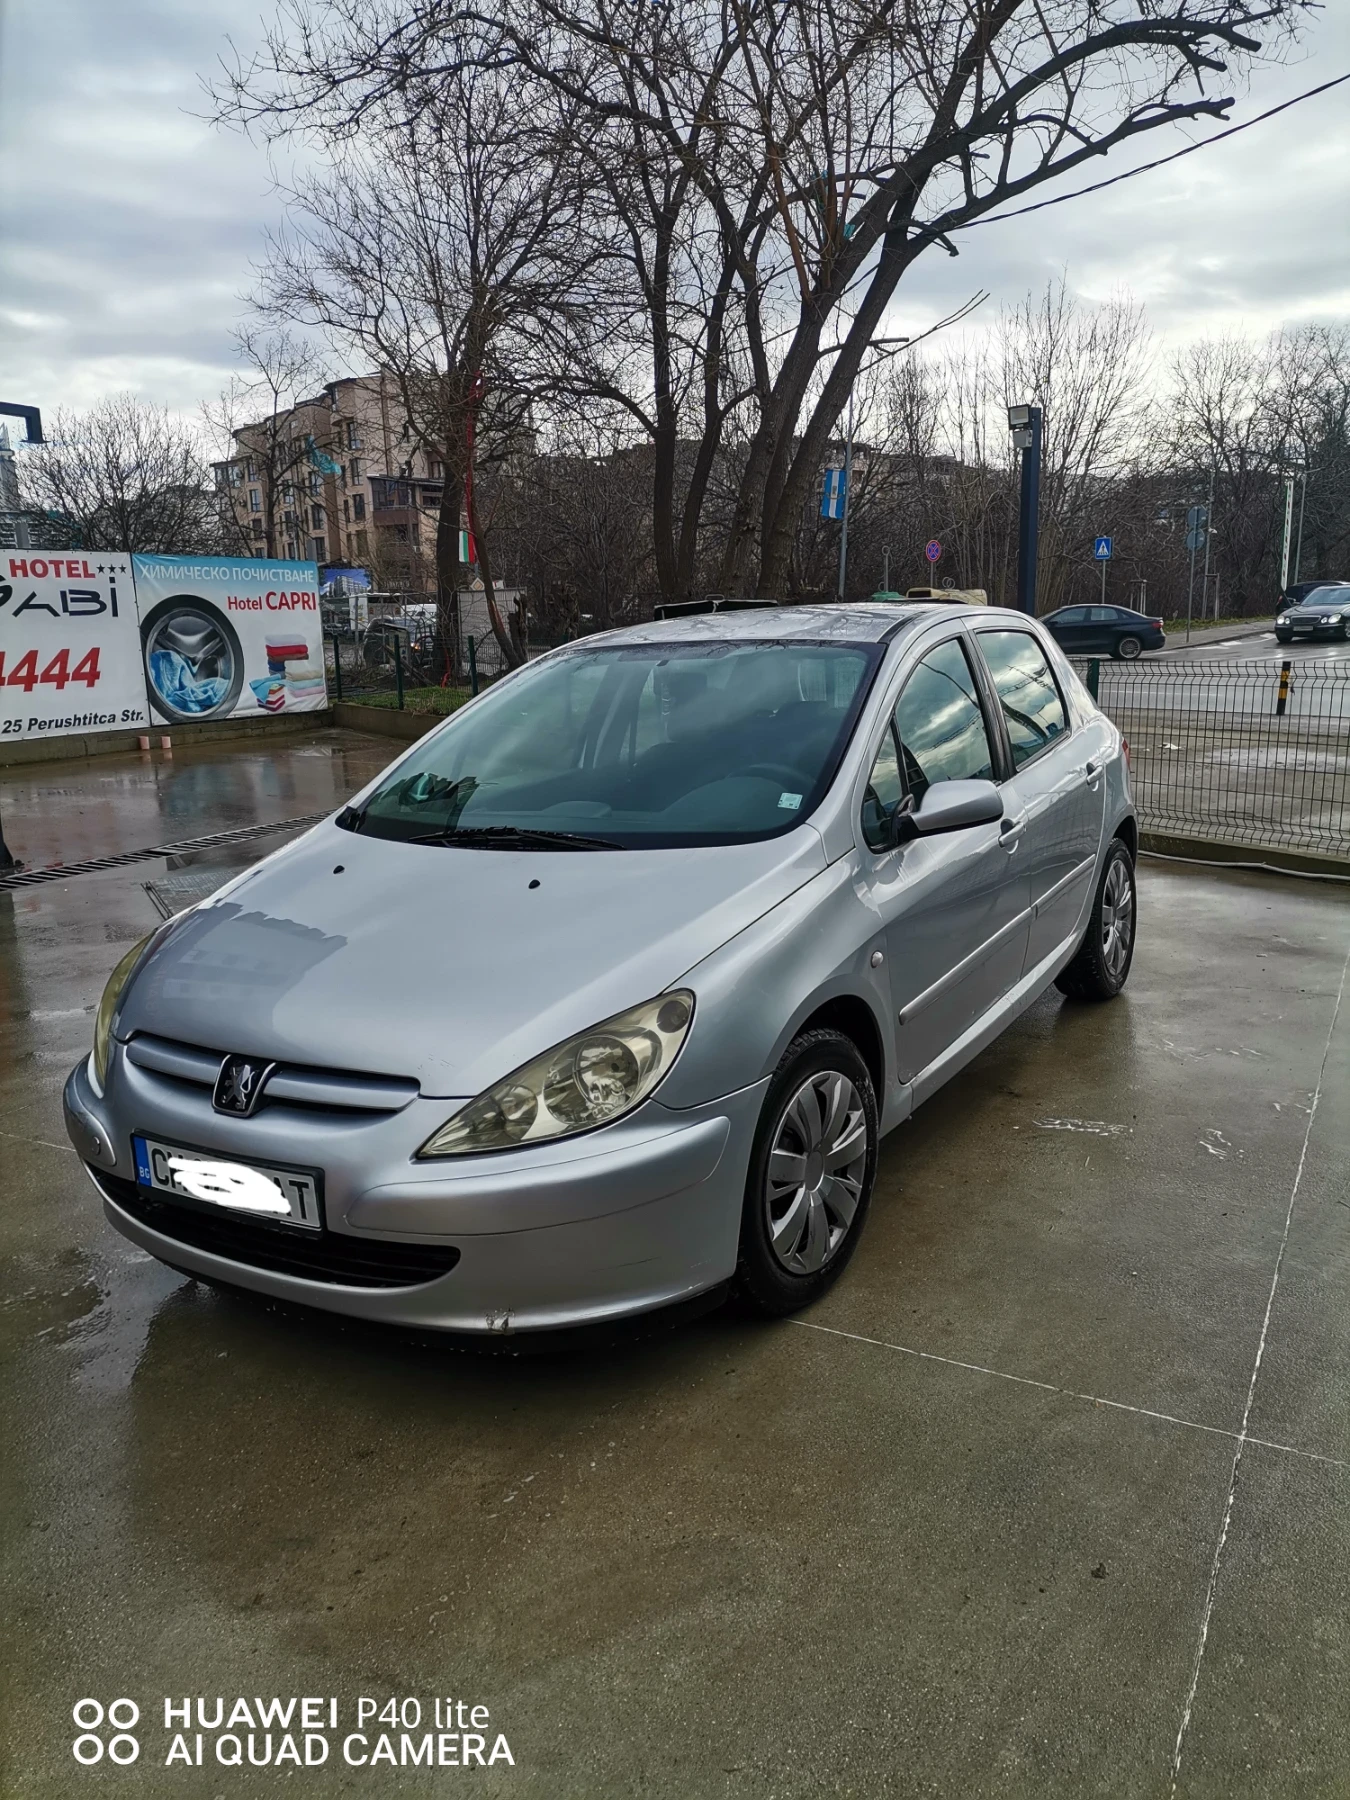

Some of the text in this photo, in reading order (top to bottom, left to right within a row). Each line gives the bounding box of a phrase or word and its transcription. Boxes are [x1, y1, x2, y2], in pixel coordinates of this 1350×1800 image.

[9, 558, 95, 578] HOTEL
[140, 564, 314, 583] ХИМИЧЕСКО ПОЧИСТВАНЕ
[227, 591, 317, 610] Hotel CAPRI
[0, 647, 101, 692] 444
[1, 709, 145, 734] 25 Perushtitca Str.
[139, 1166, 150, 1179] BG
